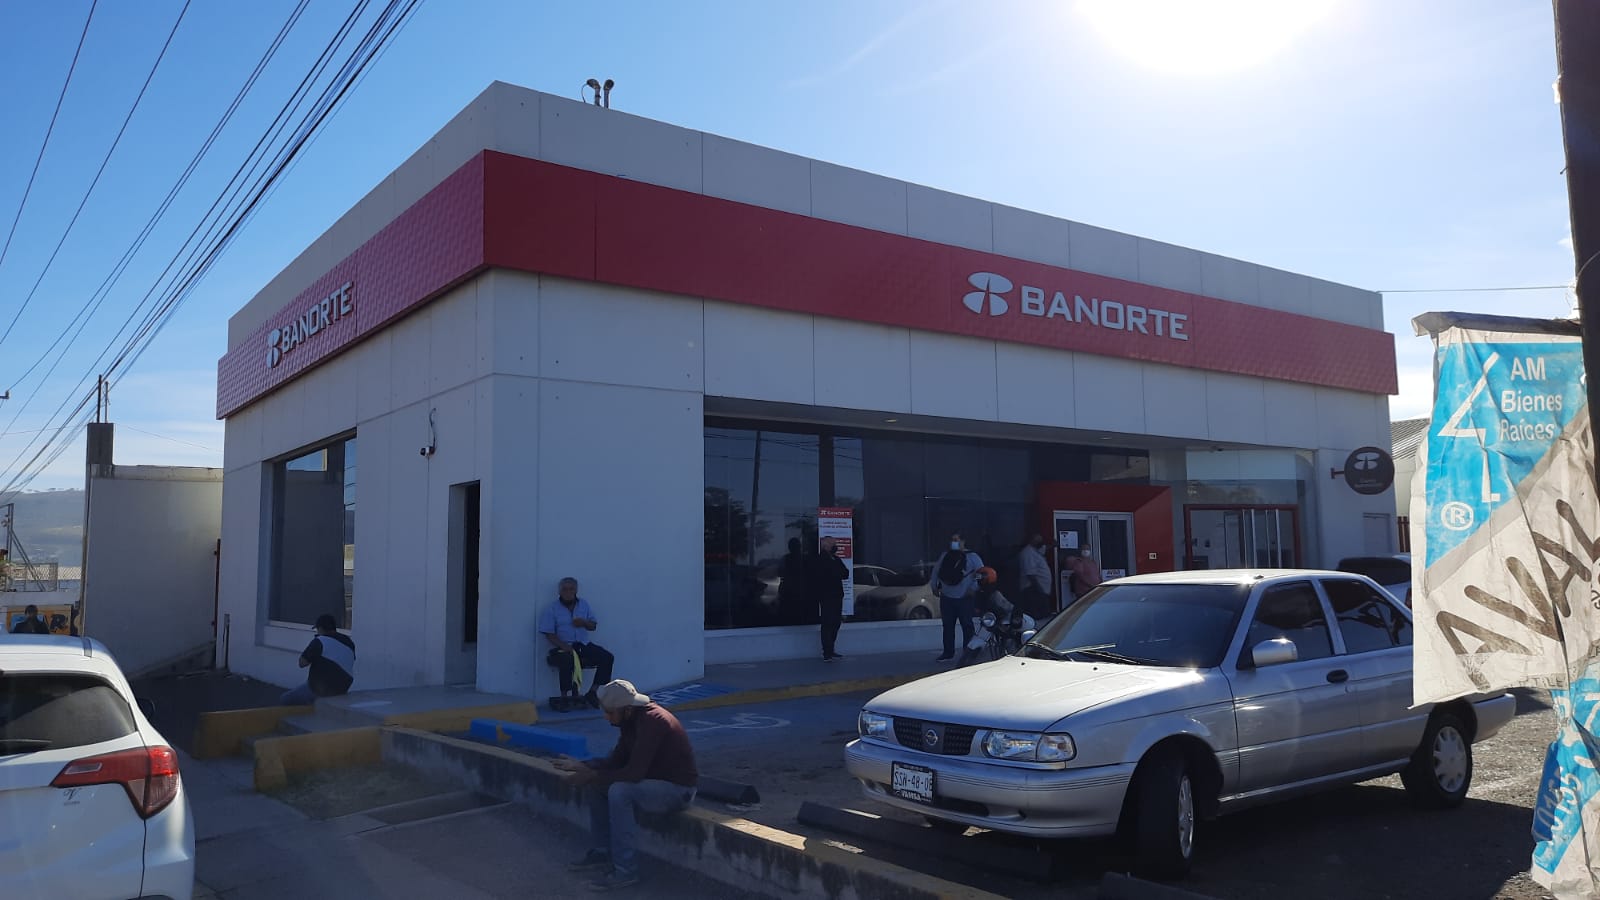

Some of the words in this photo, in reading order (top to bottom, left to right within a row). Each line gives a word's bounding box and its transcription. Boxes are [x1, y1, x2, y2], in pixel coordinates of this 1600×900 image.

[282, 281, 354, 354] BANORTE
[1021, 285, 1188, 341] BANORTE
[1510, 356, 1546, 381] AM
[1501, 390, 1562, 413] Bienes
[1500, 418, 1556, 441] Raíces
